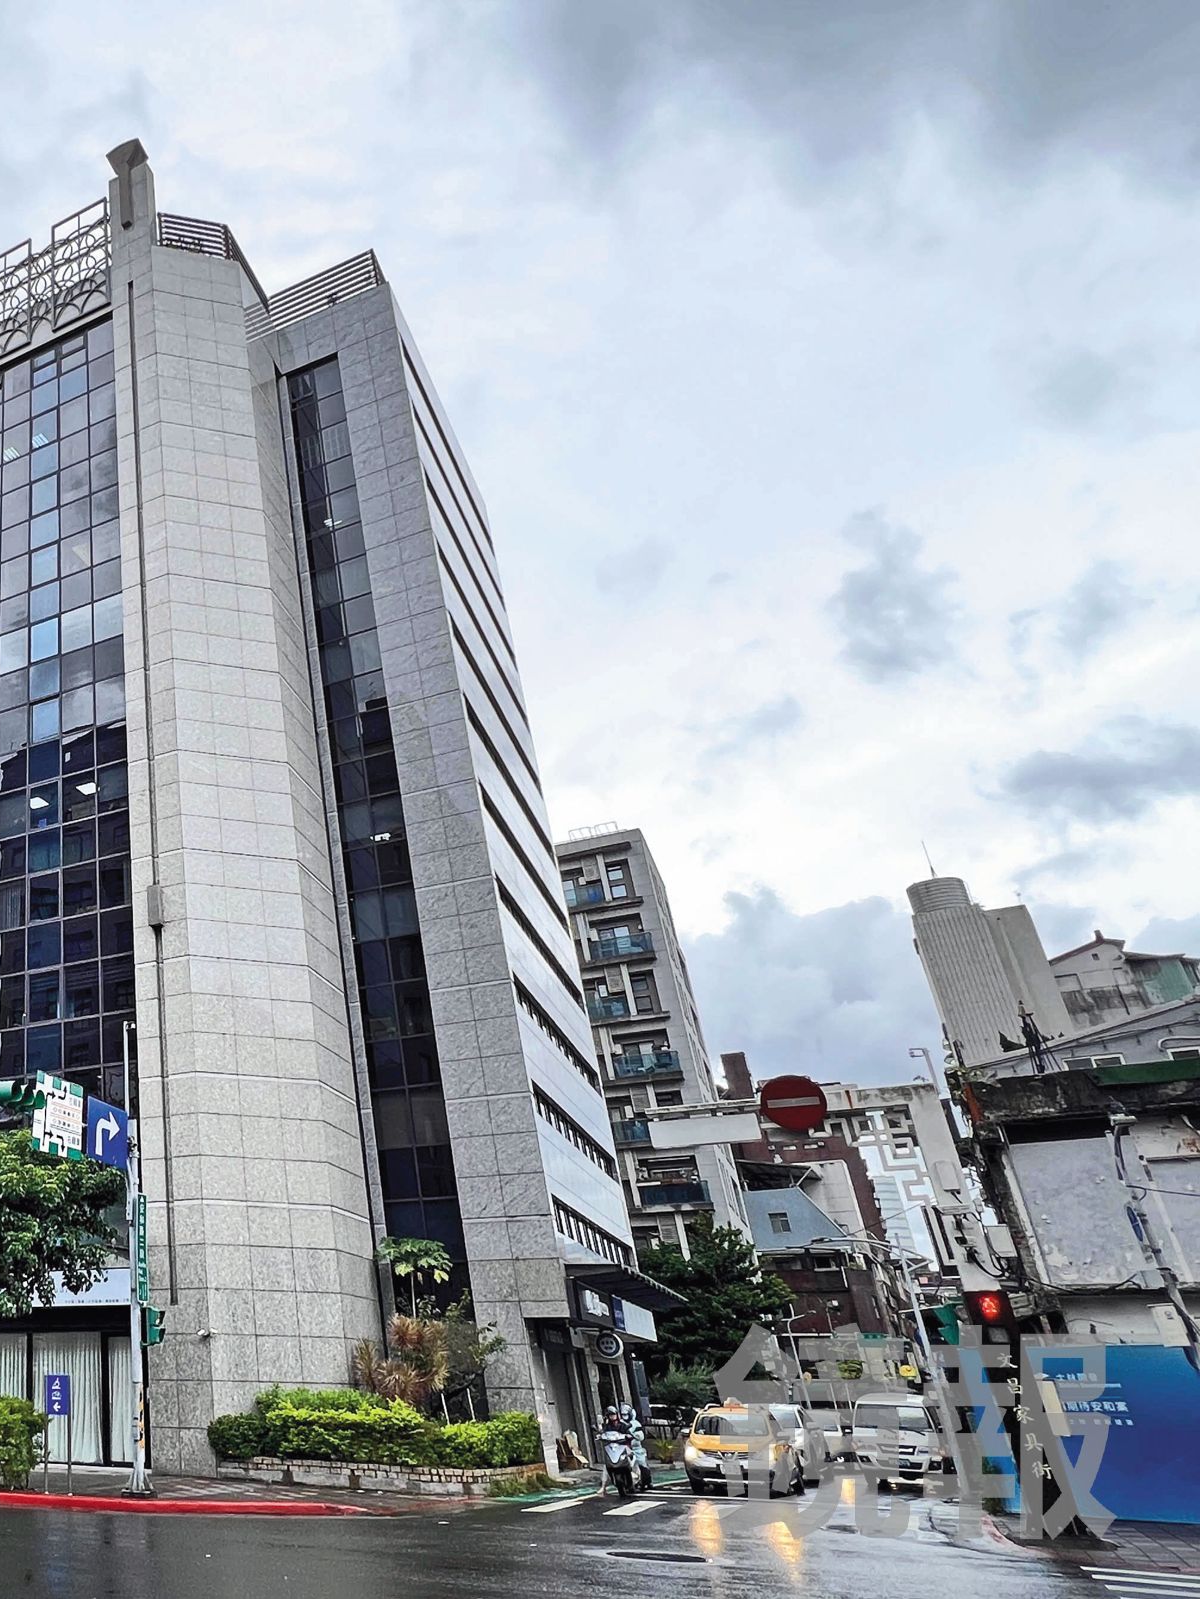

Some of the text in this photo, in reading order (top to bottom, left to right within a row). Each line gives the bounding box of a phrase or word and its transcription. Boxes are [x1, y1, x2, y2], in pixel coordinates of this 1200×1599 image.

[997, 1353, 1052, 1480] 文昌家具街
